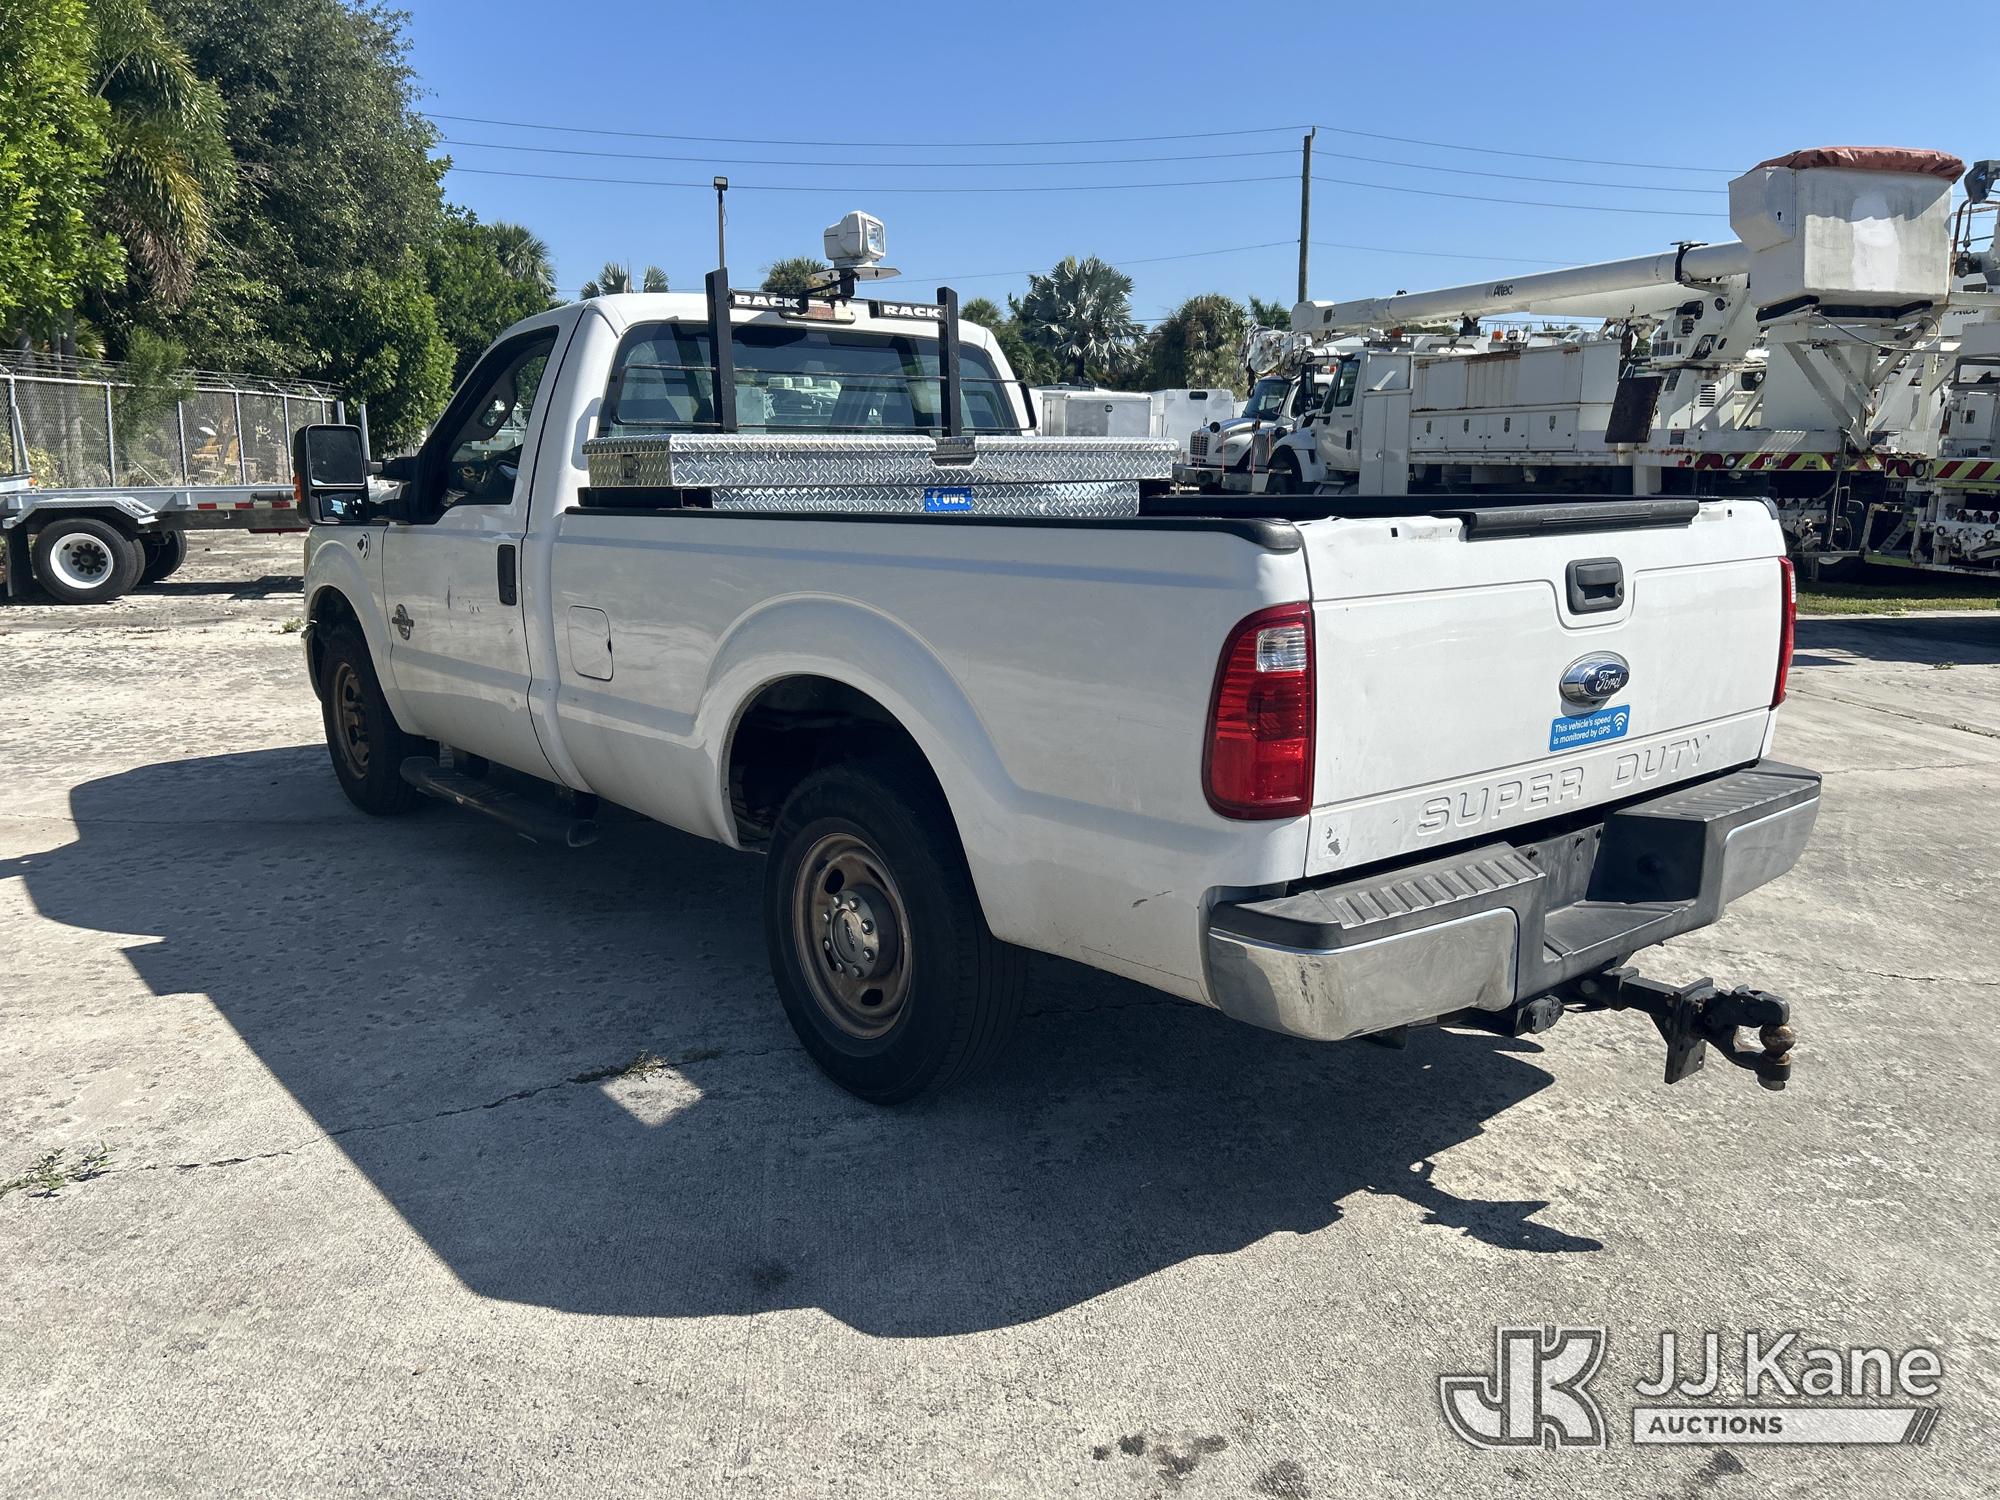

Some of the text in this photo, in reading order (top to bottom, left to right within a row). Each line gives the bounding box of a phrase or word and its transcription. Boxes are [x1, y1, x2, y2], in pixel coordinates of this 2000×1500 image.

[734, 294, 942, 319] BACK RACK
[942, 493, 966, 504] UWS
[1595, 669, 1622, 692] Ford
[1555, 714, 1611, 733] This vehicle's speed
[1553, 725, 1611, 744] is monitored by GPS
[1416, 733, 1711, 837] SUPER DUTY
